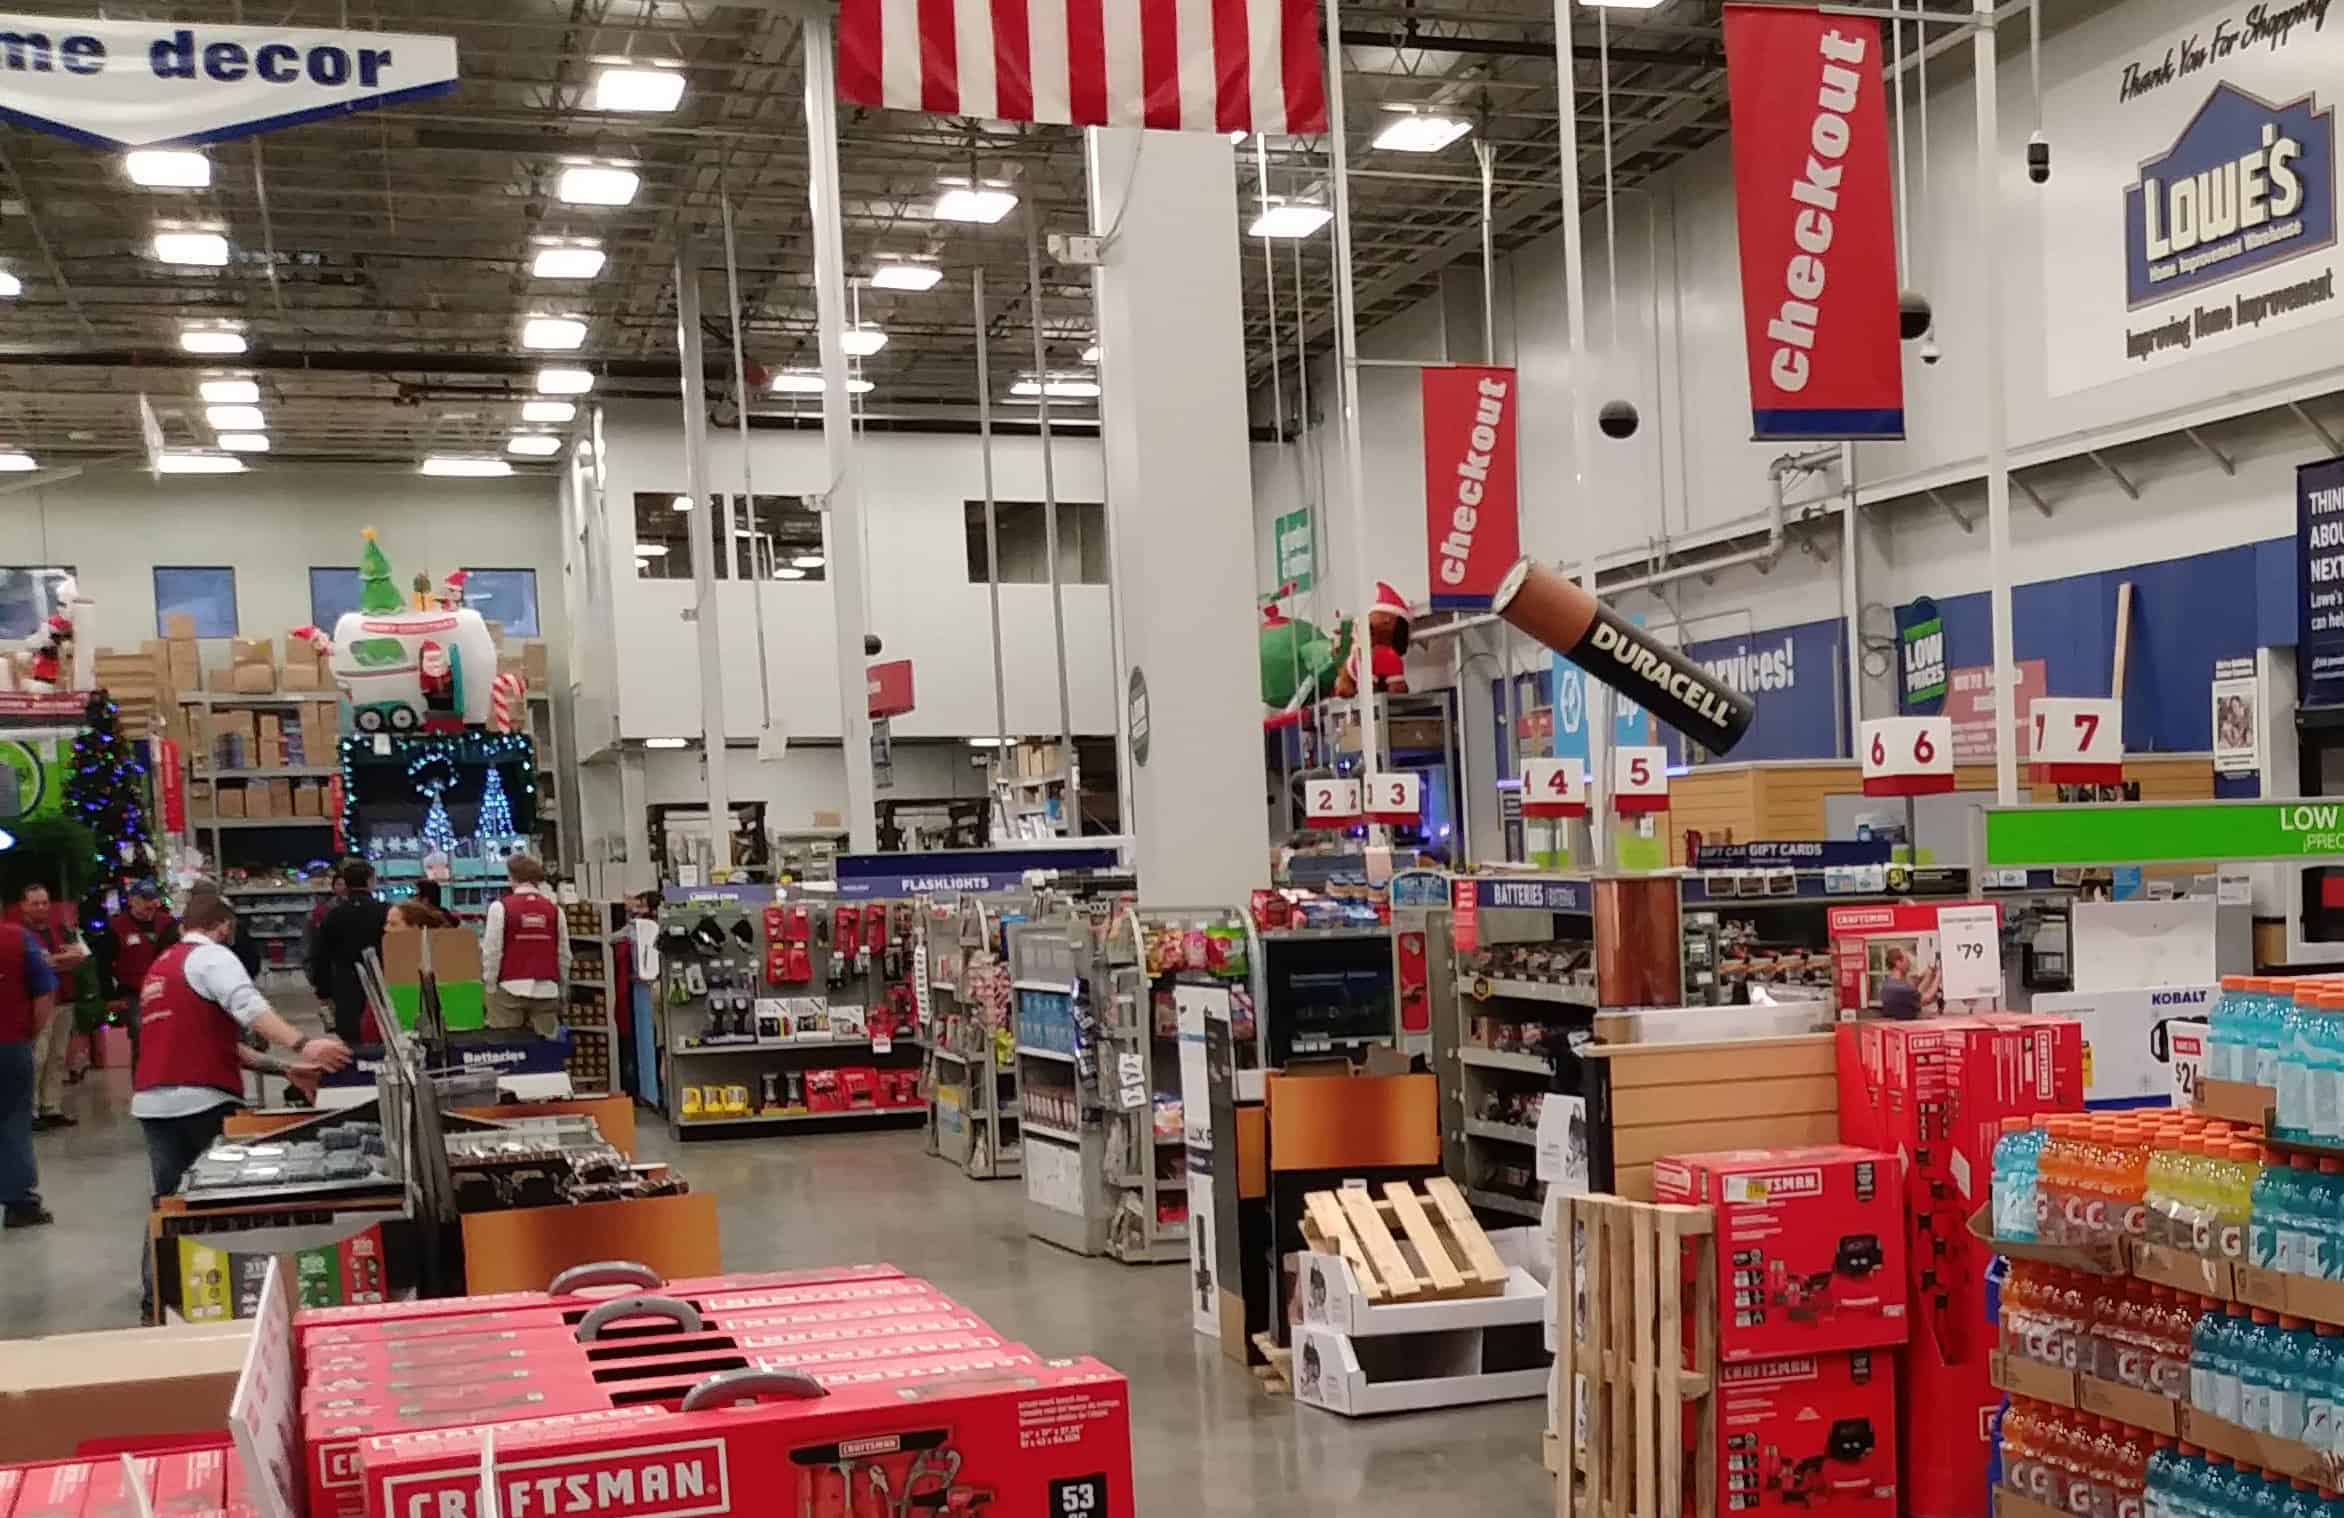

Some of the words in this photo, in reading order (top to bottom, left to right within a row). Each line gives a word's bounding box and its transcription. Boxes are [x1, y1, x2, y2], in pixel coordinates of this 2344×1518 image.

[150, 30, 392, 87] decor
[2119, 47, 2175, 103] Thank
[2179, 34, 2206, 77] You
[2210, 19, 2240, 64] For
[2241, 0, 2331, 51] Shopping
[2145, 123, 2302, 262] LOWE'S
[1768, 29, 1866, 393] Checkout
[2126, 314, 2190, 361] Improving
[2194, 306, 2233, 339] Home
[2236, 267, 2334, 328] Improvement
[1440, 377, 1508, 585] Checkout
[1905, 631, 1943, 673] LOW
[1591, 622, 1729, 728] DURACELL
[1914, 730, 1934, 763] 6
[2074, 714, 2099, 752] 7
[1548, 769, 1568, 795] 4
[1631, 757, 1650, 786] 5
[1318, 790, 1333, 810] 2
[1391, 783, 1405, 805] 3
[2281, 806, 2338, 832] LOW
[1750, 843, 1778, 857] GIFT
[1779, 843, 1823, 857] CARDS
[902, 876, 989, 892] FLASHLIGHTS
[1494, 883, 1544, 906] BATTERIES
[2152, 990, 2207, 1005] KOBALT
[2220, 1226, 2241, 1257] G
[1062, 1483, 1095, 1512] 53
